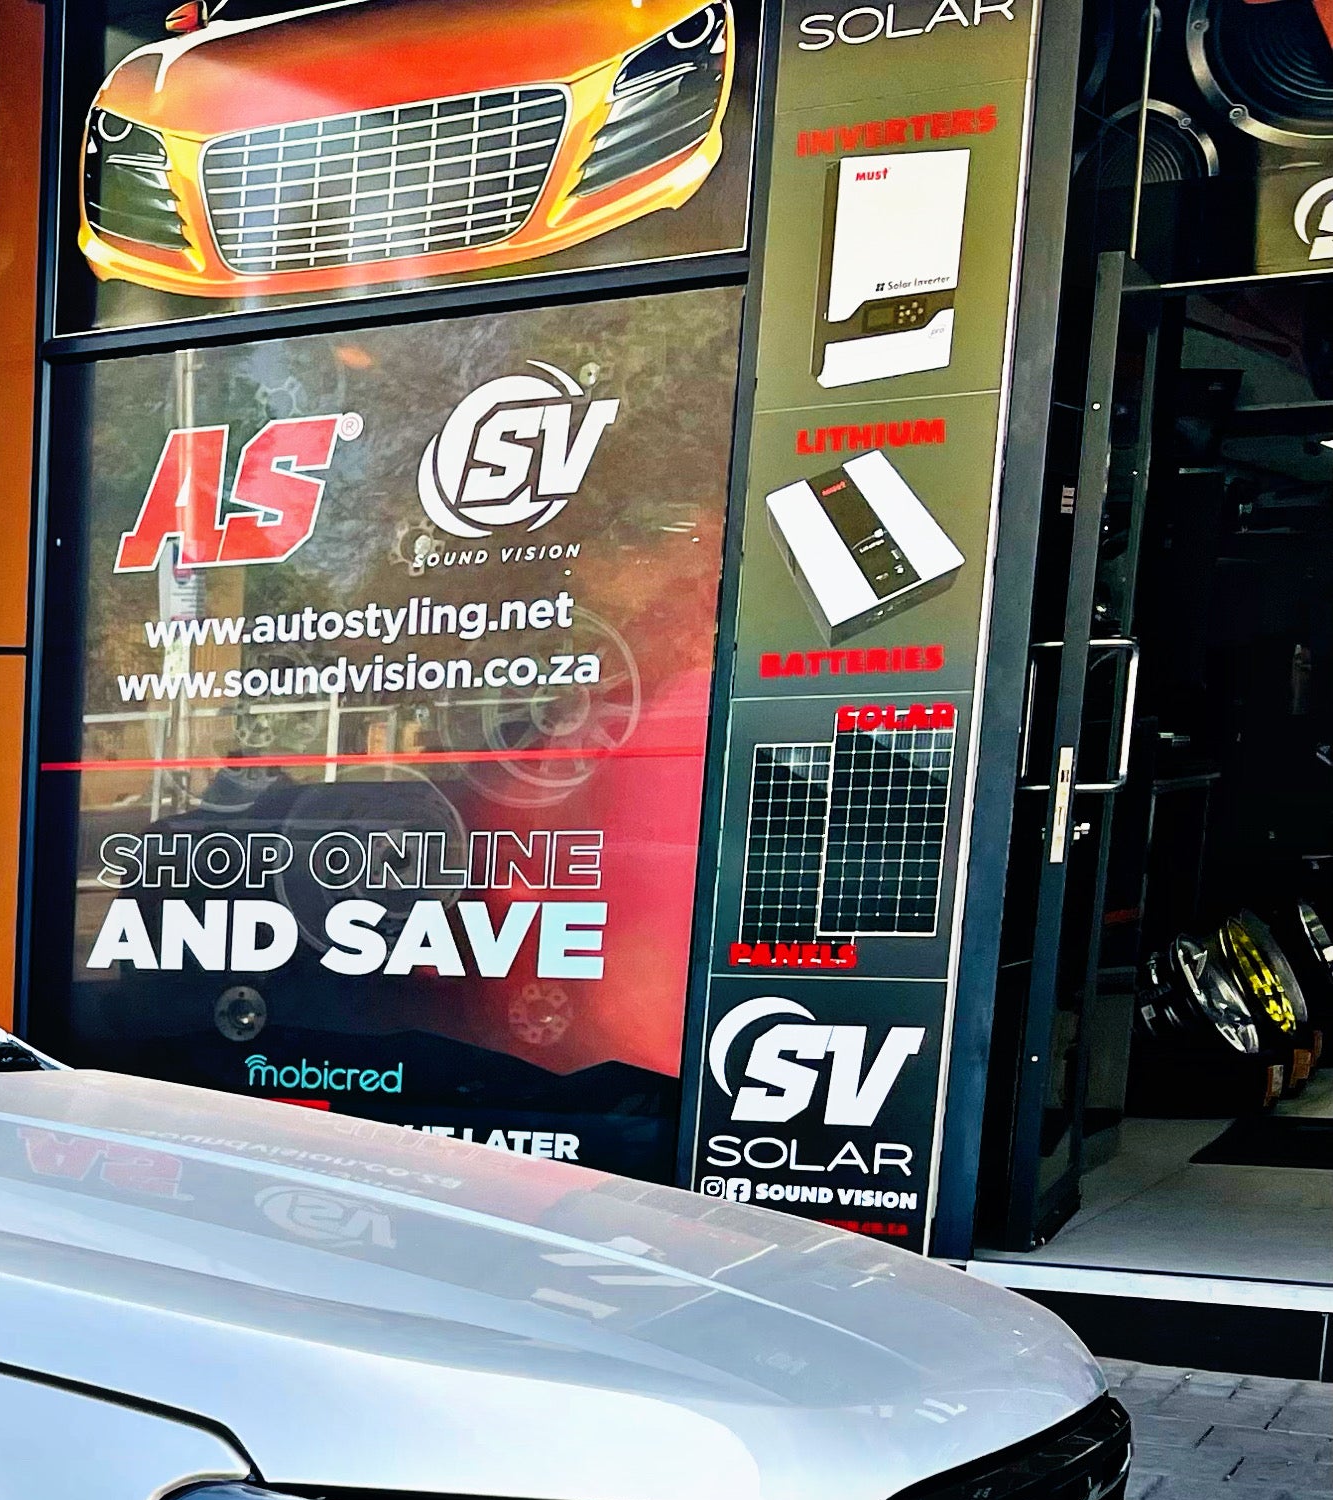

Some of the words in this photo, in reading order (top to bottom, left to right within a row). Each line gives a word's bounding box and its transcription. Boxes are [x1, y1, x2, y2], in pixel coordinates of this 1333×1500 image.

[798, 0, 1015, 50] SOLAR
[795, 104, 998, 158] INVERTERS
[887, 281, 912, 291] Solar
[914, 275, 950, 287] Inverter
[795, 418, 946, 454] LITHIUM
[113, 413, 344, 574] AS
[413, 548, 488, 569] SOUND
[500, 542, 581, 562] VISION
[144, 591, 574, 649] www.autostyling.net
[117, 652, 602, 703] www.soundvision.co.za
[760, 644, 944, 679] BATTERIES
[837, 702, 955, 731] SOLAR
[96, 832, 294, 890] SHOP
[309, 831, 605, 890] ONLINE
[86, 900, 298, 972] AND
[320, 901, 608, 980] SAVE
[729, 942, 858, 969] PANELS
[248, 1056, 404, 1094] mobicred
[731, 1022, 926, 1127] SV
[706, 1135, 913, 1176] SOLAR
[755, 1183, 833, 1204] SOUND
[836, 1188, 917, 1210] VISION
